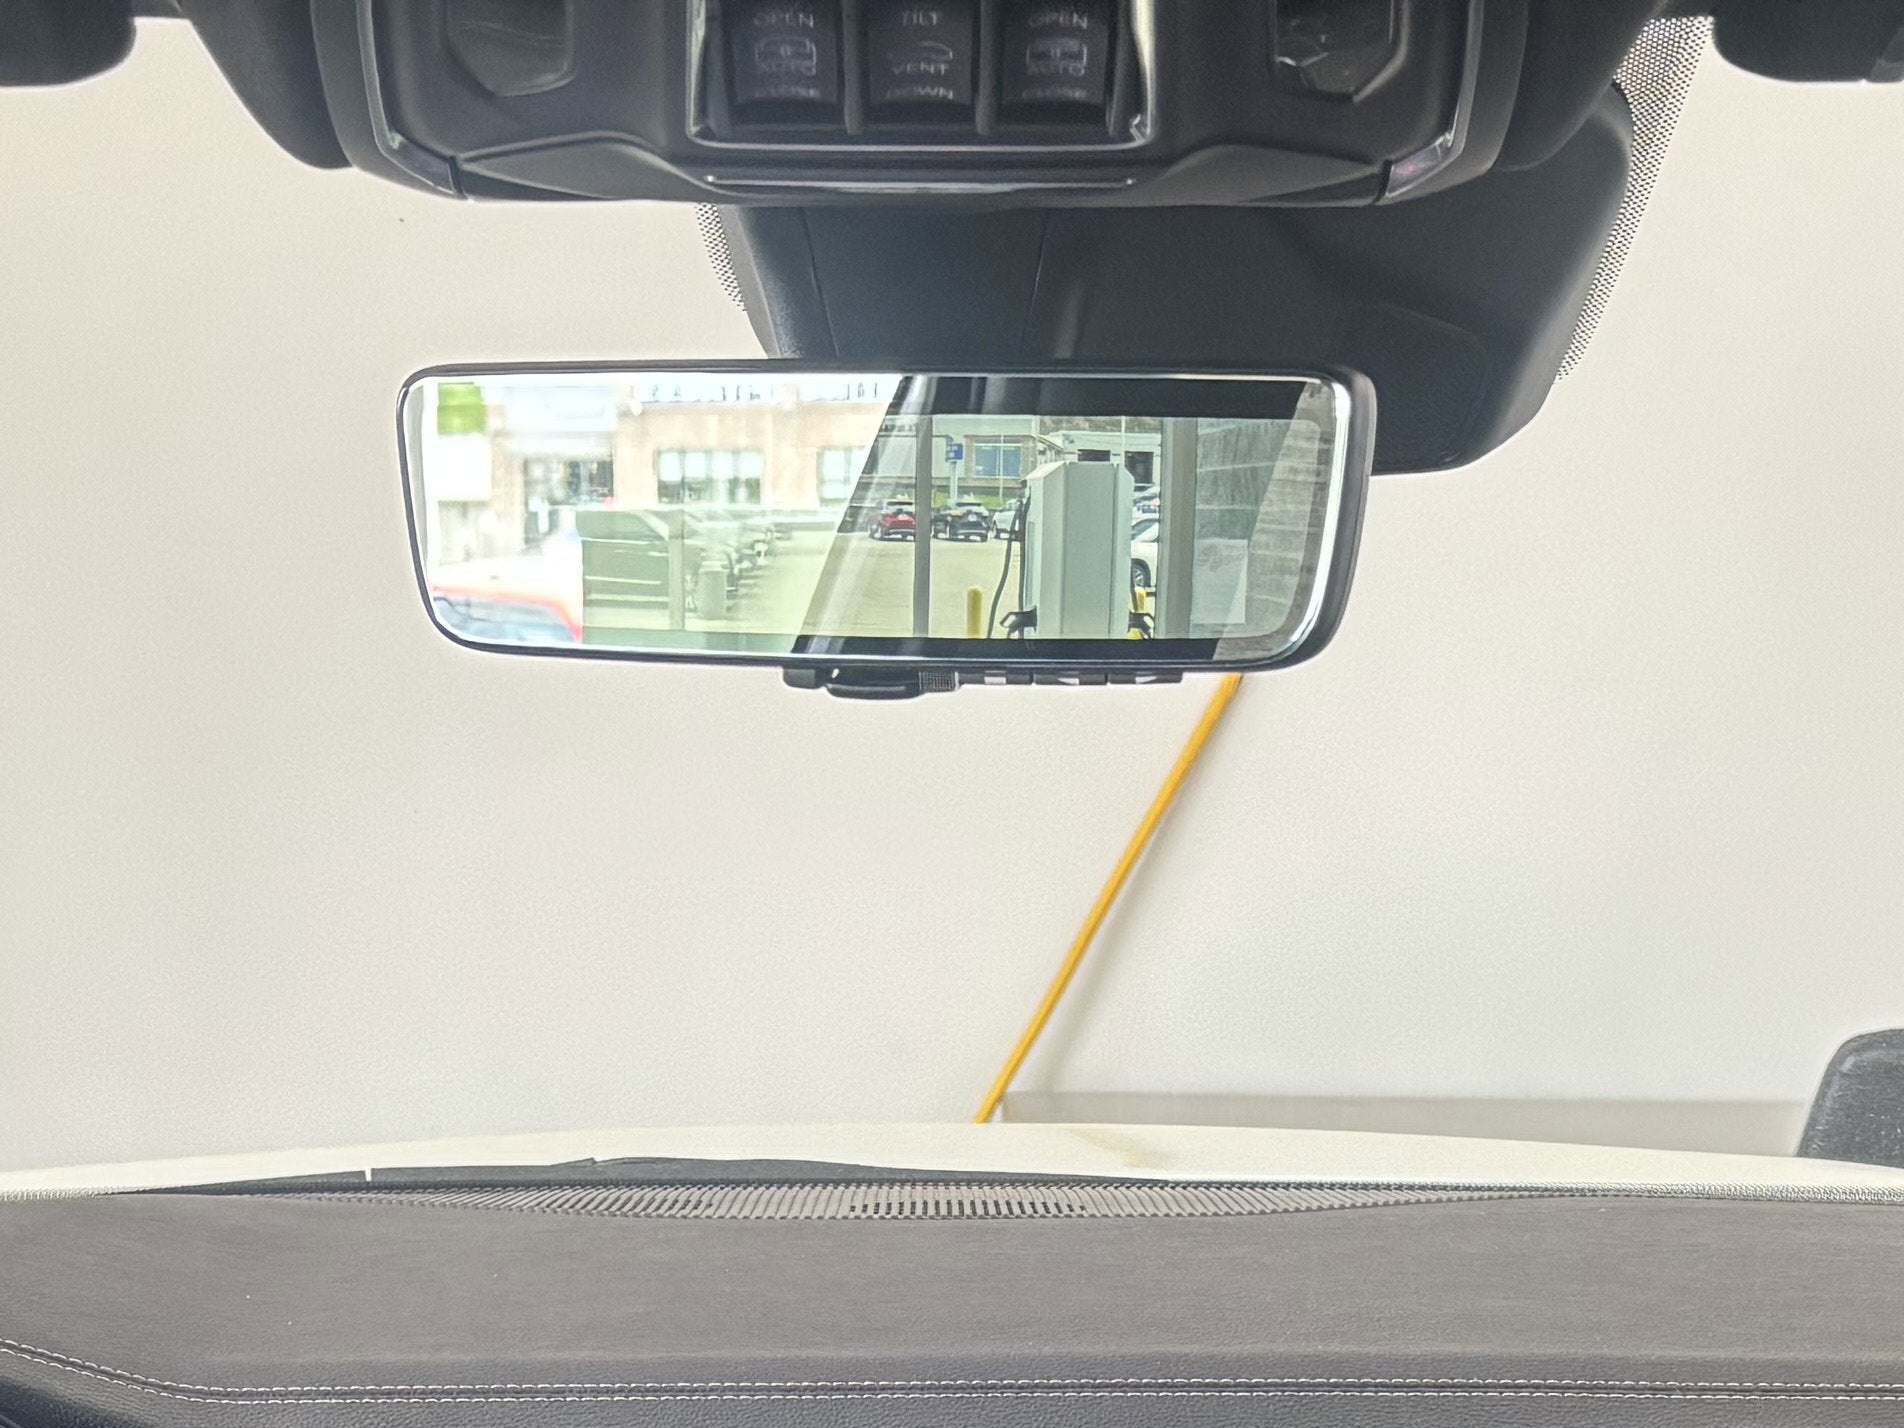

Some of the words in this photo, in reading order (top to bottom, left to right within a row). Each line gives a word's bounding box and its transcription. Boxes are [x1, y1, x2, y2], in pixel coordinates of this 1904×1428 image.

[752, 12, 815, 28] OPEN
[902, 11, 942, 27] TILT
[1029, 12, 1088, 29] OPEN
[891, 62, 950, 76] VENT
